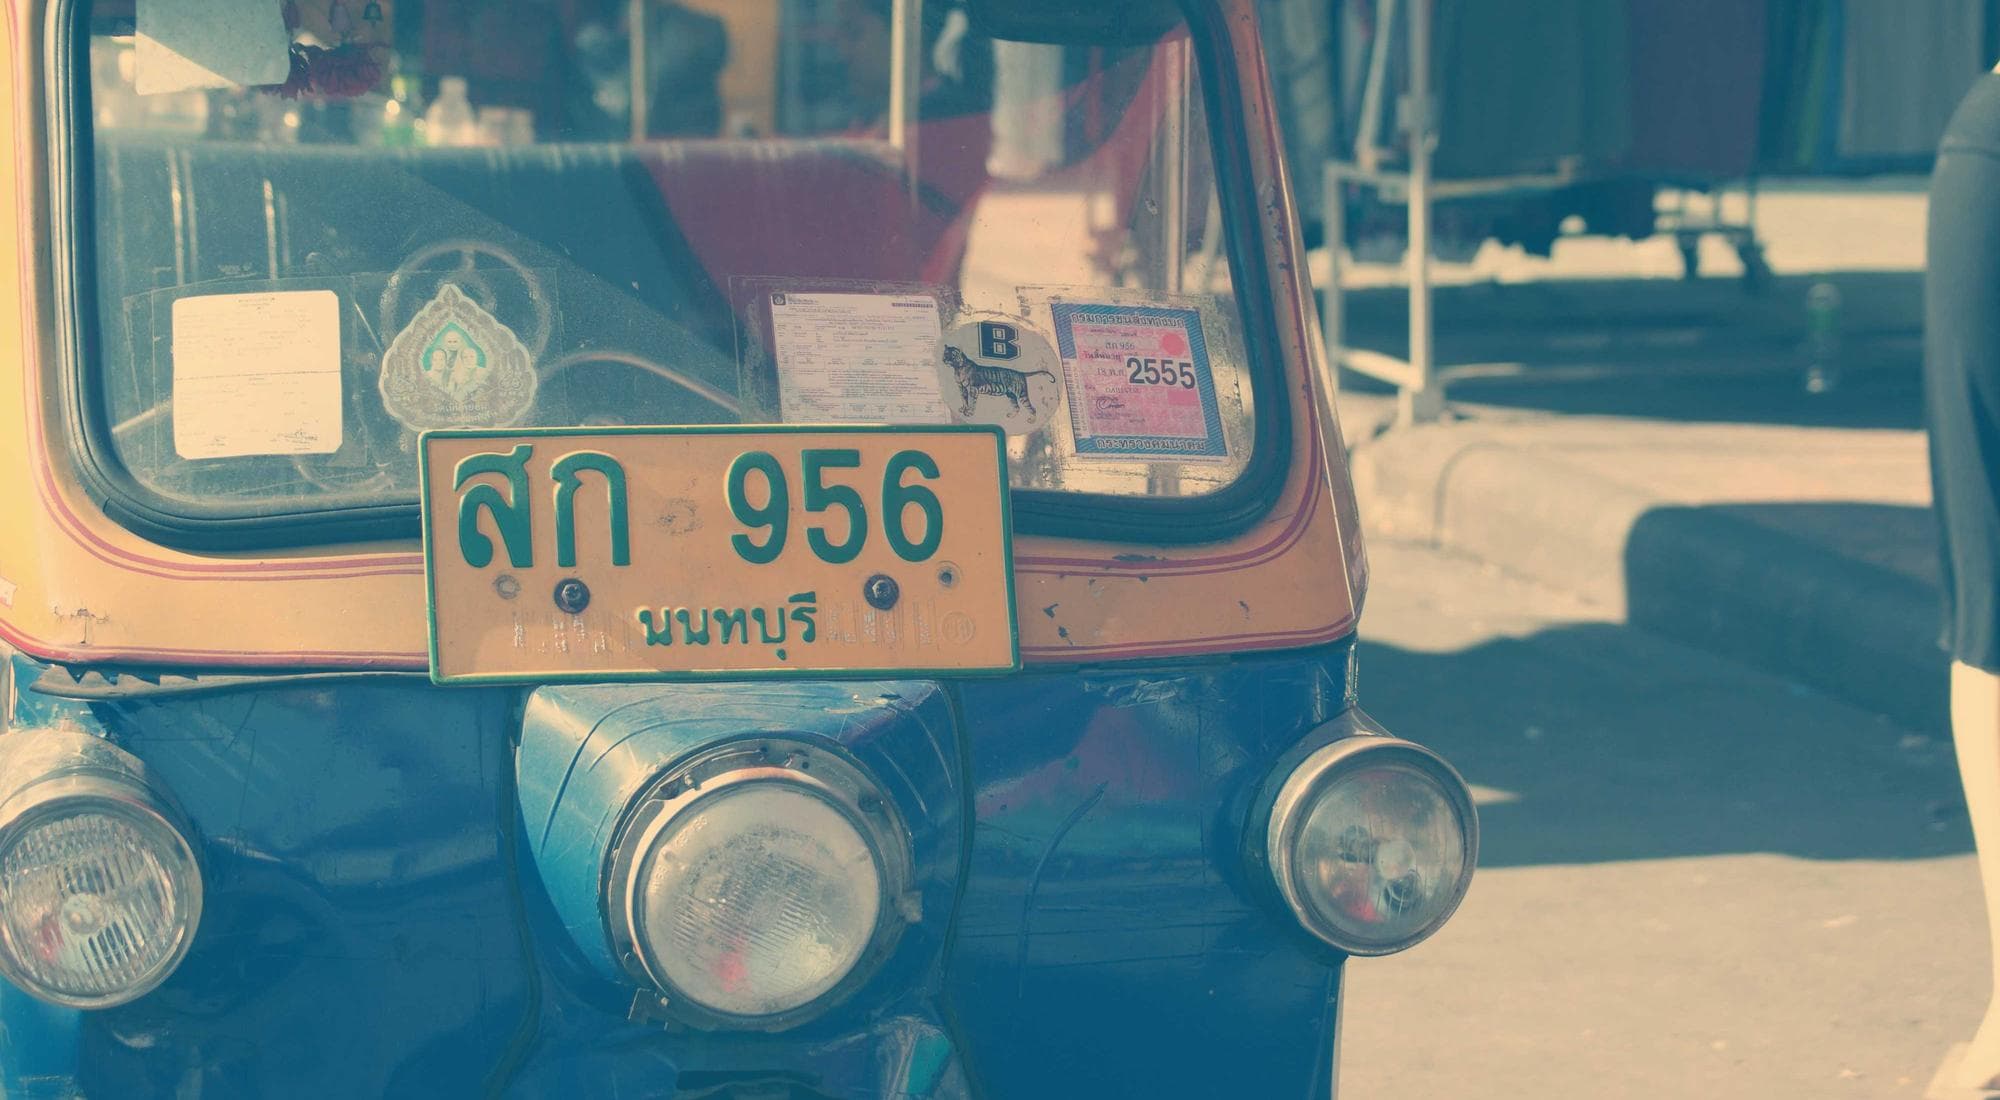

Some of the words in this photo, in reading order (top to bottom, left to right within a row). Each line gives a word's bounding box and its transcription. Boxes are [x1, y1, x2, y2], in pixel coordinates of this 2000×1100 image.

[1071, 312, 1185, 328] กรมการขนส่งทางบก
[978, 321, 1021, 361] B
[1127, 358, 1195, 389] 2555
[453, 444, 631, 568] สก
[726, 448, 944, 565] 956
[638, 591, 816, 660] นนทบุรี
